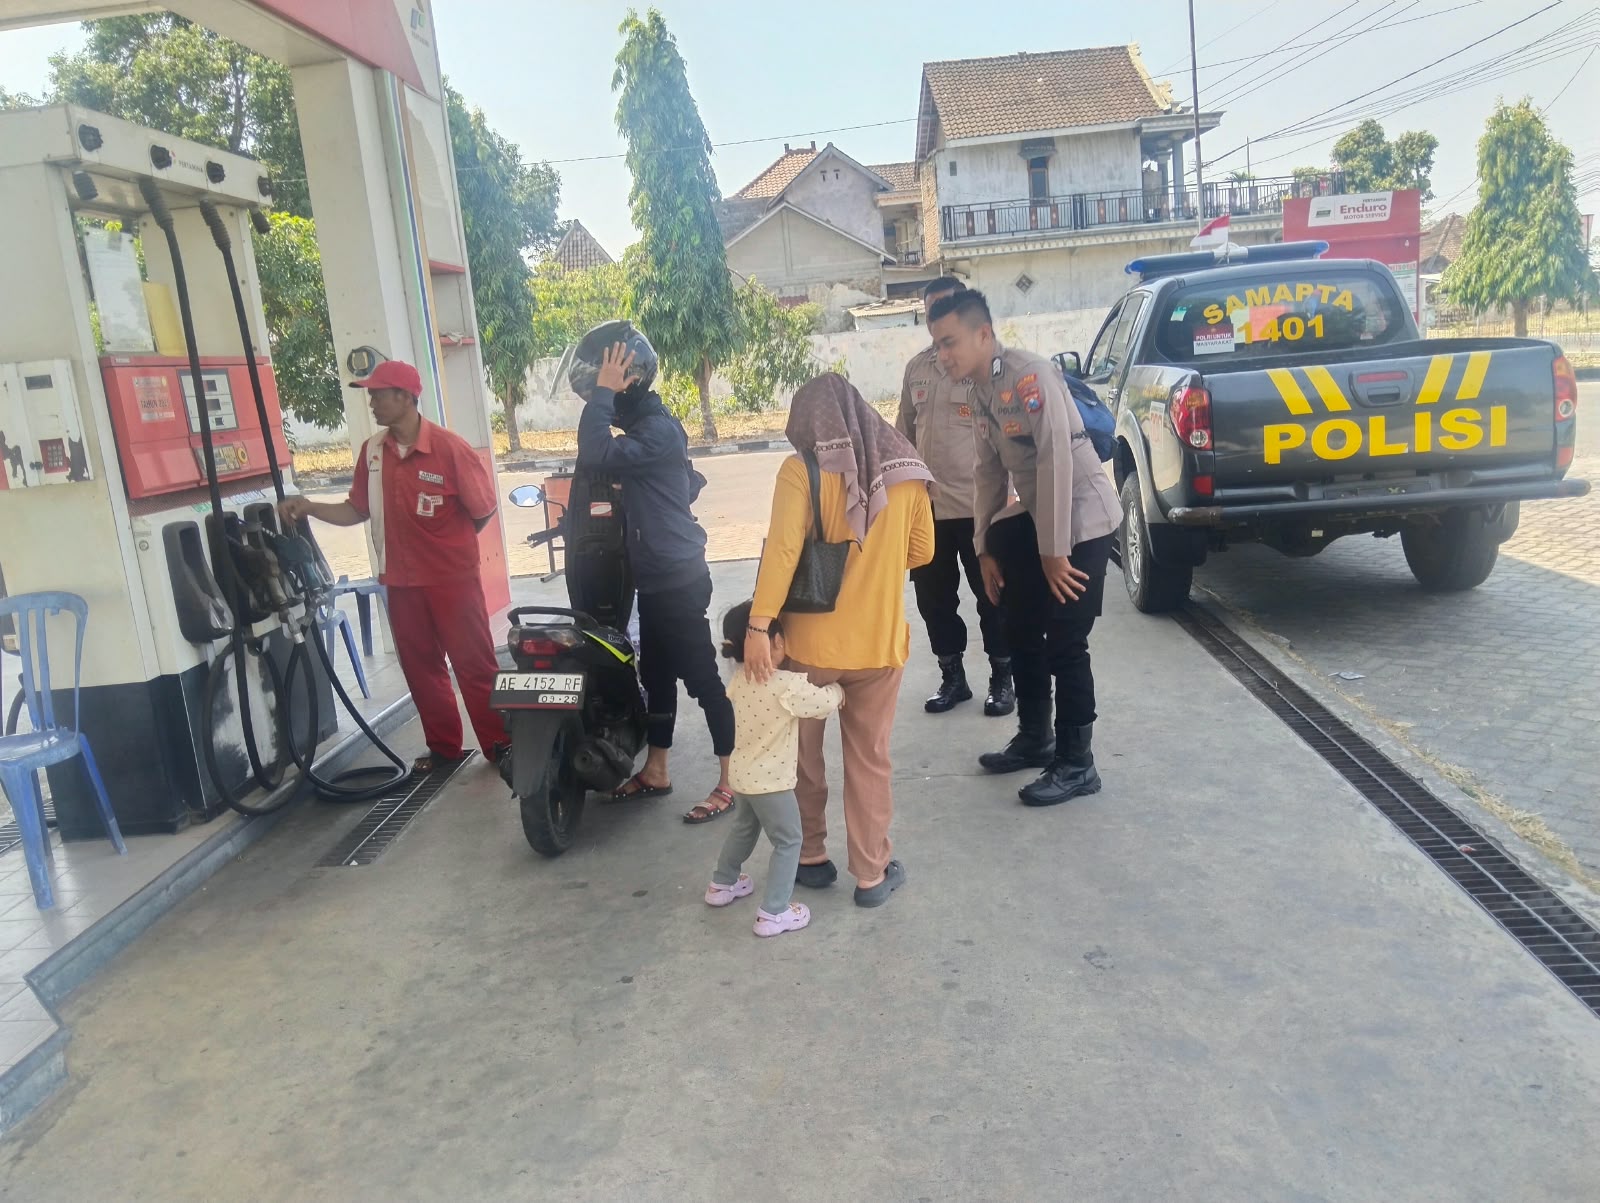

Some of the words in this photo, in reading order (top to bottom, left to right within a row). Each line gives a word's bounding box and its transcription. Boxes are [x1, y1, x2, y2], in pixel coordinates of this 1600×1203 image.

[1340, 203, 1387, 213] Enduro
[1203, 283, 1353, 325] SAMAPTA
[1237, 314, 1324, 345] 1401
[1195, 339, 1232, 347] MASYARAKAT
[1263, 405, 1507, 465] POLISI
[500, 677, 516, 690] AE
[523, 676, 556, 690] 4152
[564, 677, 581, 690] RF
